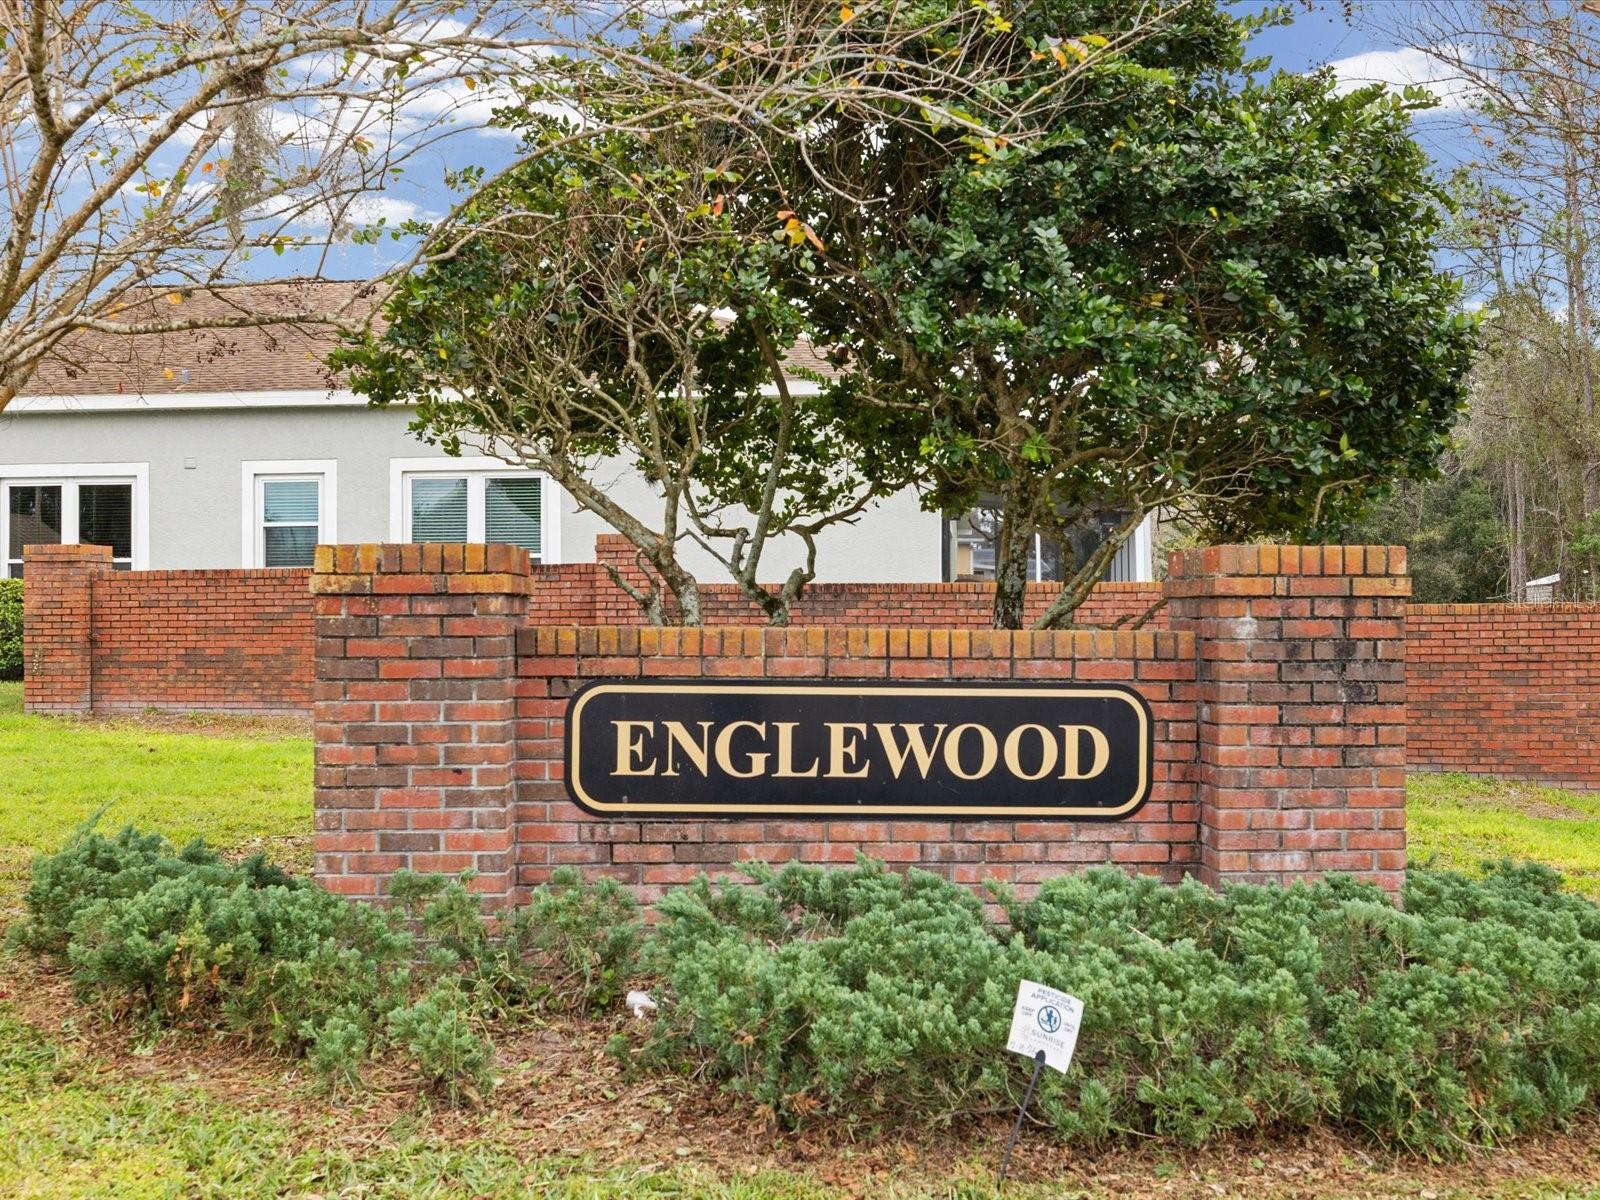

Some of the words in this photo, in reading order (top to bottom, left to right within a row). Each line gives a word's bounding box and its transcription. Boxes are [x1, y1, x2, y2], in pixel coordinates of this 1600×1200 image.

[609, 720, 1110, 781] ENGLEWOOD
[1031, 993, 1074, 1013] APPLICATION
[1038, 988, 1071, 1004] PESTICIDE
[1031, 1029, 1065, 1048] SUNRISE
